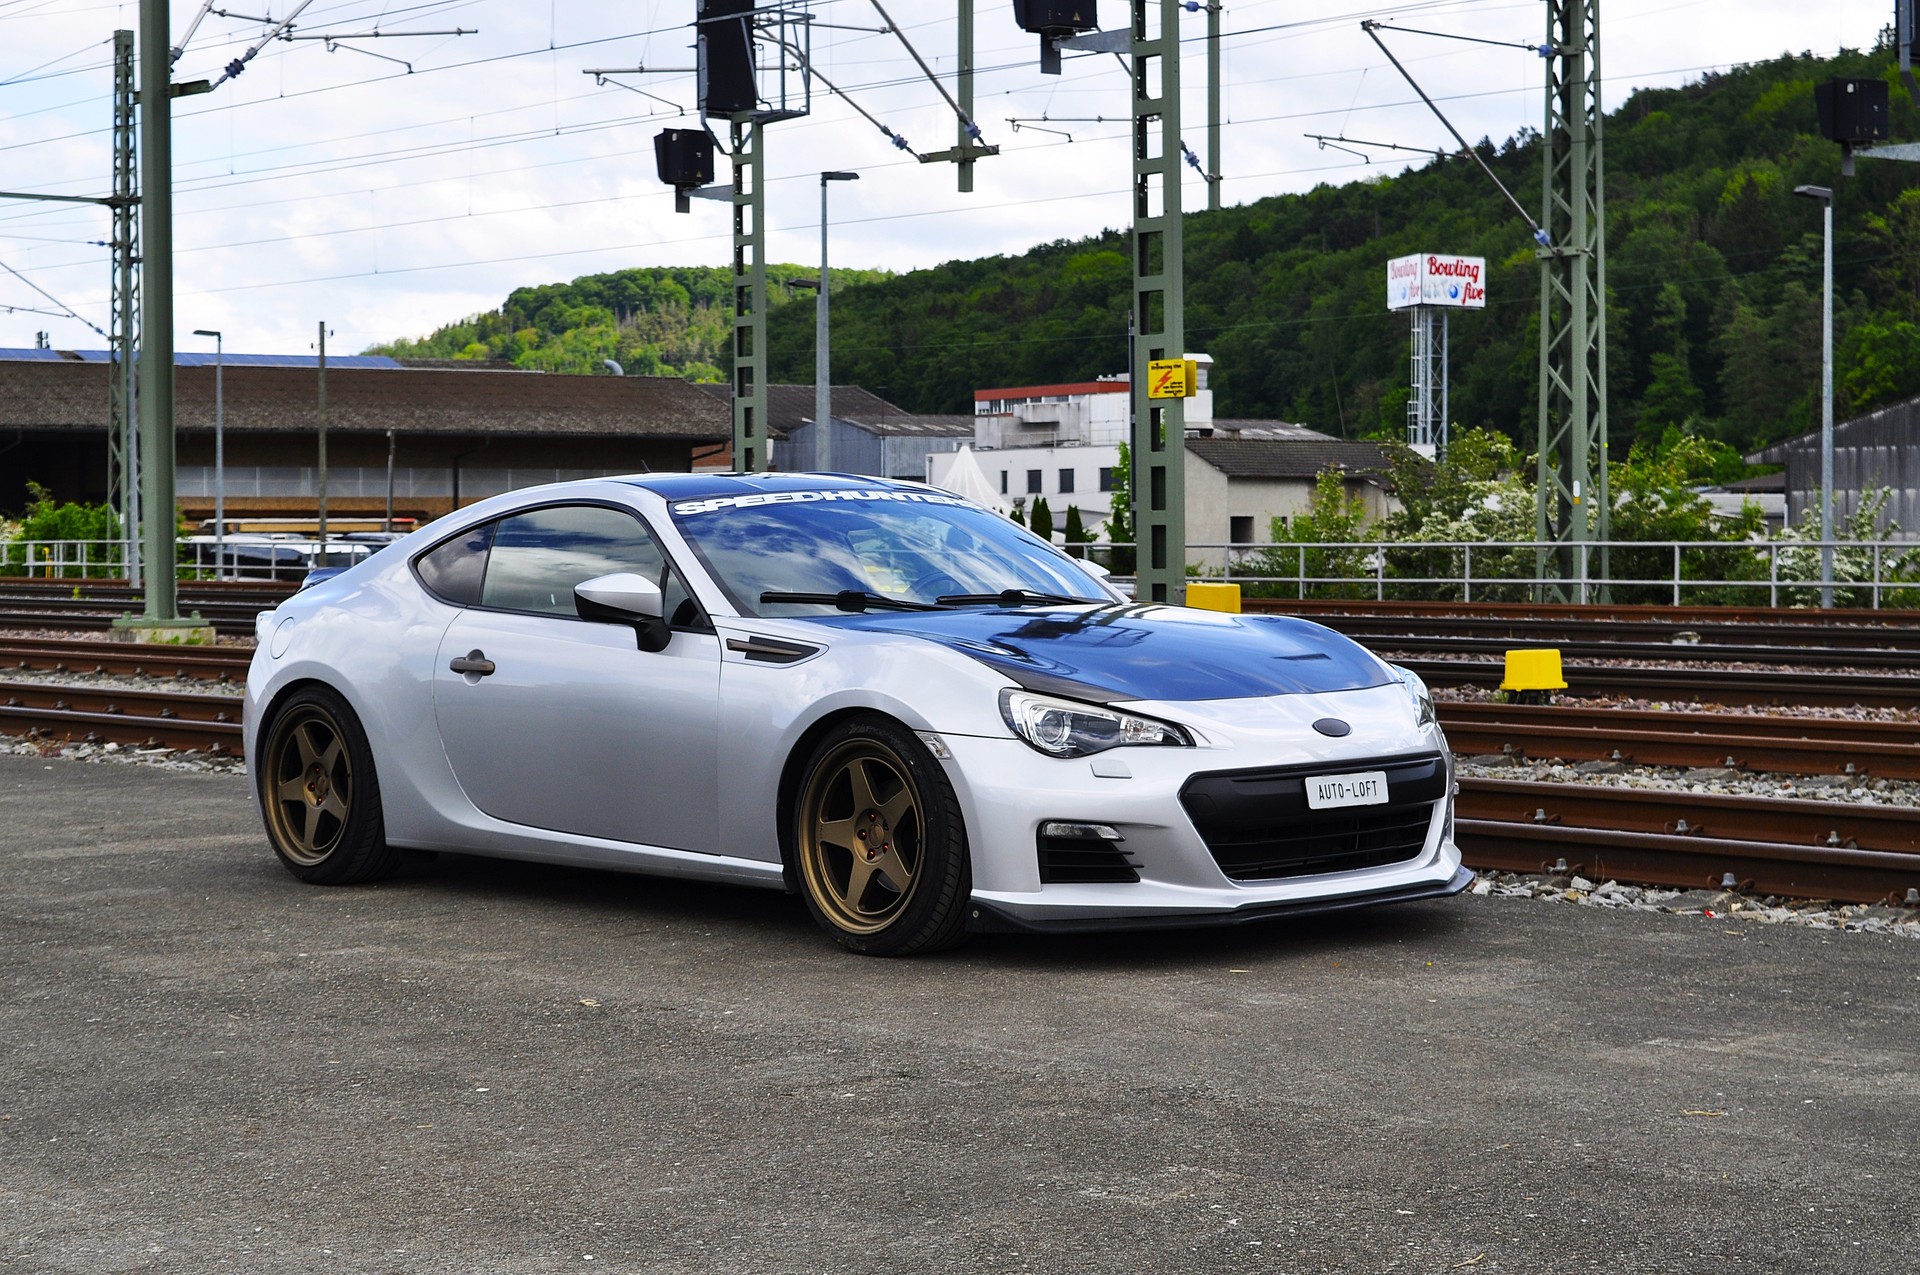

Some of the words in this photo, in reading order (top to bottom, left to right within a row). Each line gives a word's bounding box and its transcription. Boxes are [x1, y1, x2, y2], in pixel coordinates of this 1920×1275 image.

[1391, 259, 1418, 280] Bowling
[1427, 256, 1480, 284] Bowling
[1462, 281, 1484, 305] five
[1318, 780, 1377, 801] AUTO-LOFT
